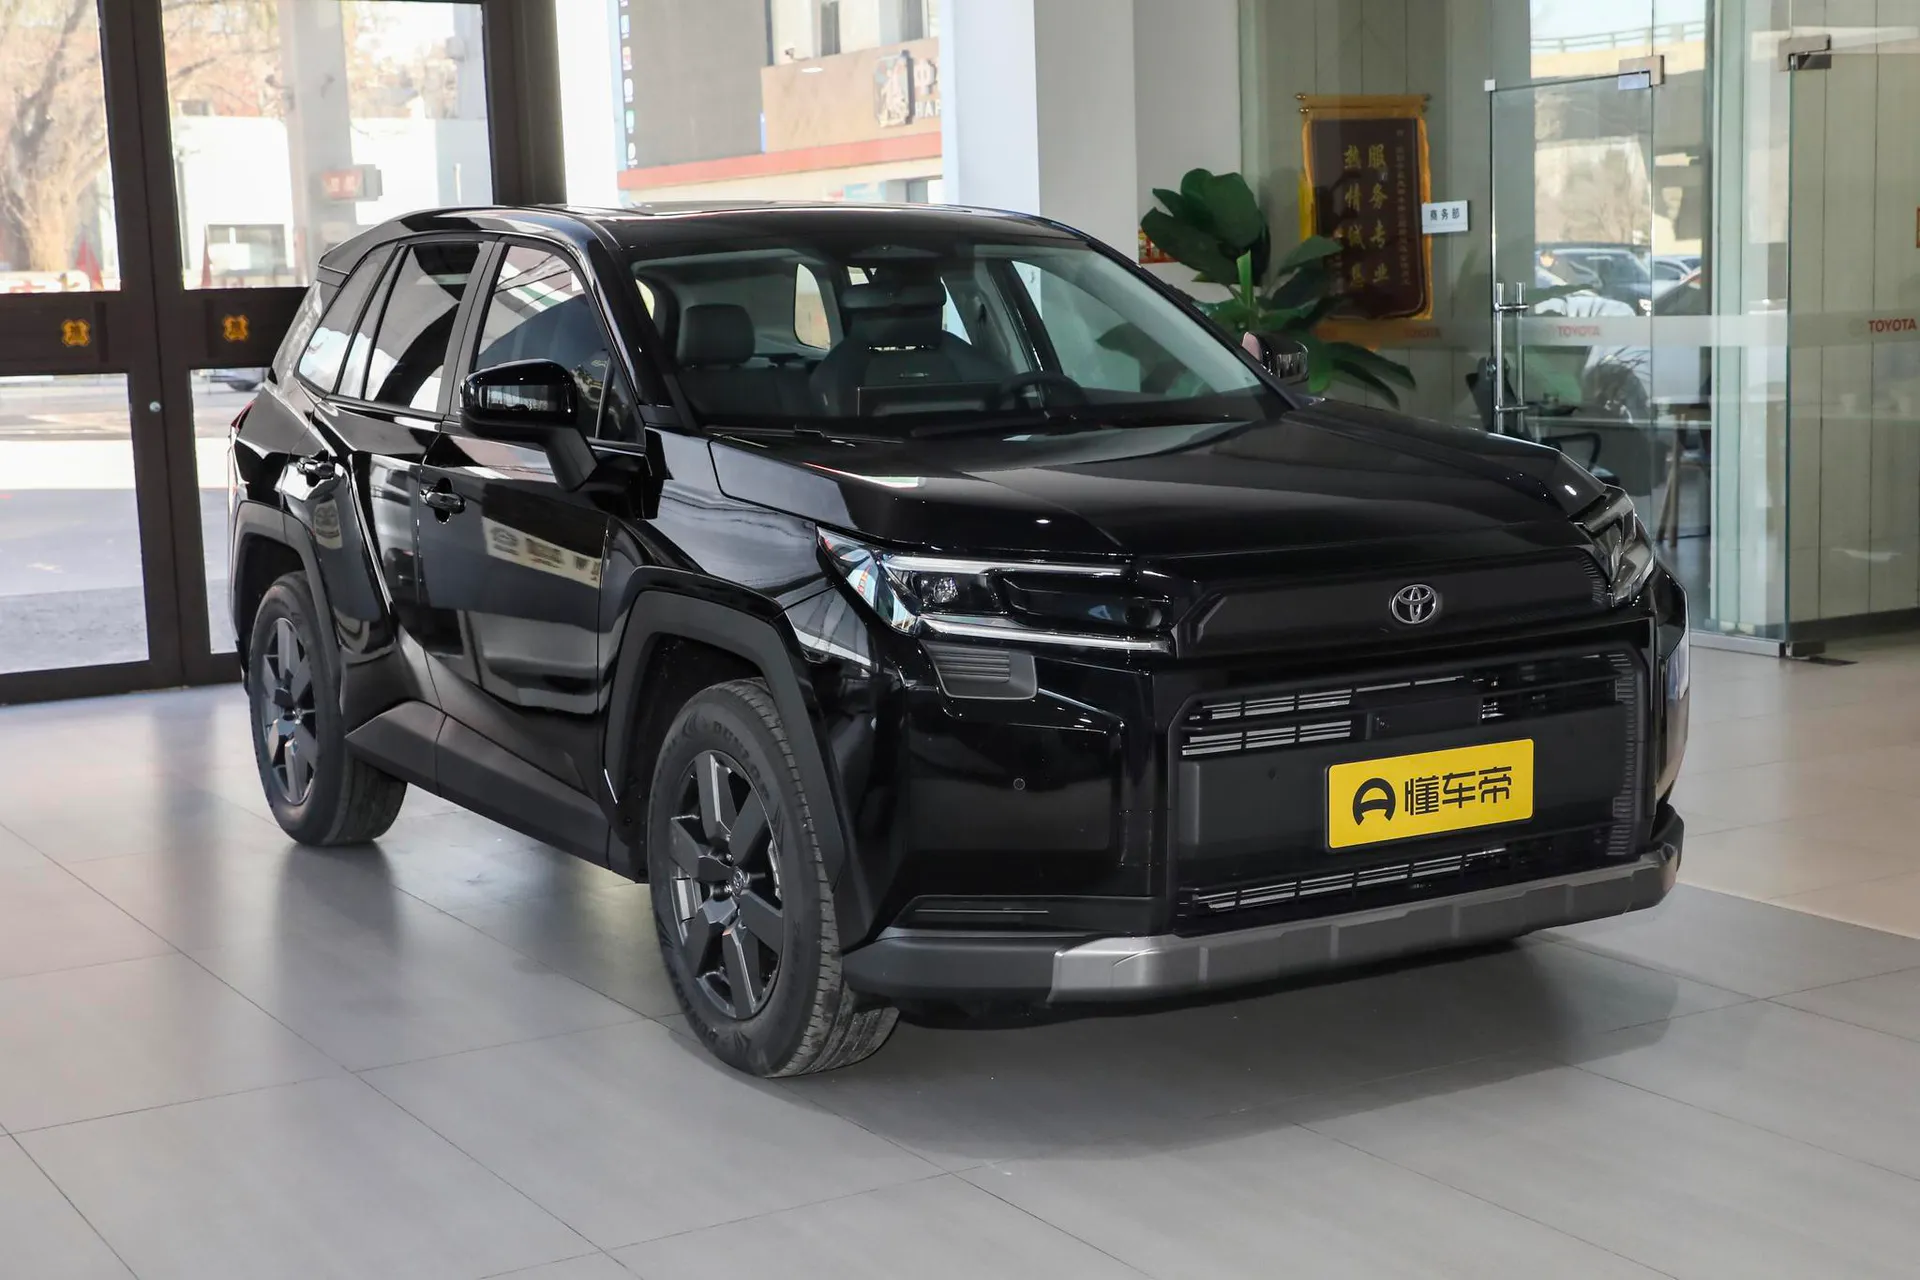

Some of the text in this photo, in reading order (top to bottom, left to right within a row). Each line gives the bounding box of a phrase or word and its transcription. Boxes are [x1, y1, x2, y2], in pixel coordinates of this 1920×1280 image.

[1368, 144, 1390, 284] 服务专业
[1557, 325, 1601, 339] TOYOTA
[1868, 318, 1917, 333] TOYOTA
[1404, 766, 1512, 815] 懂车帝
